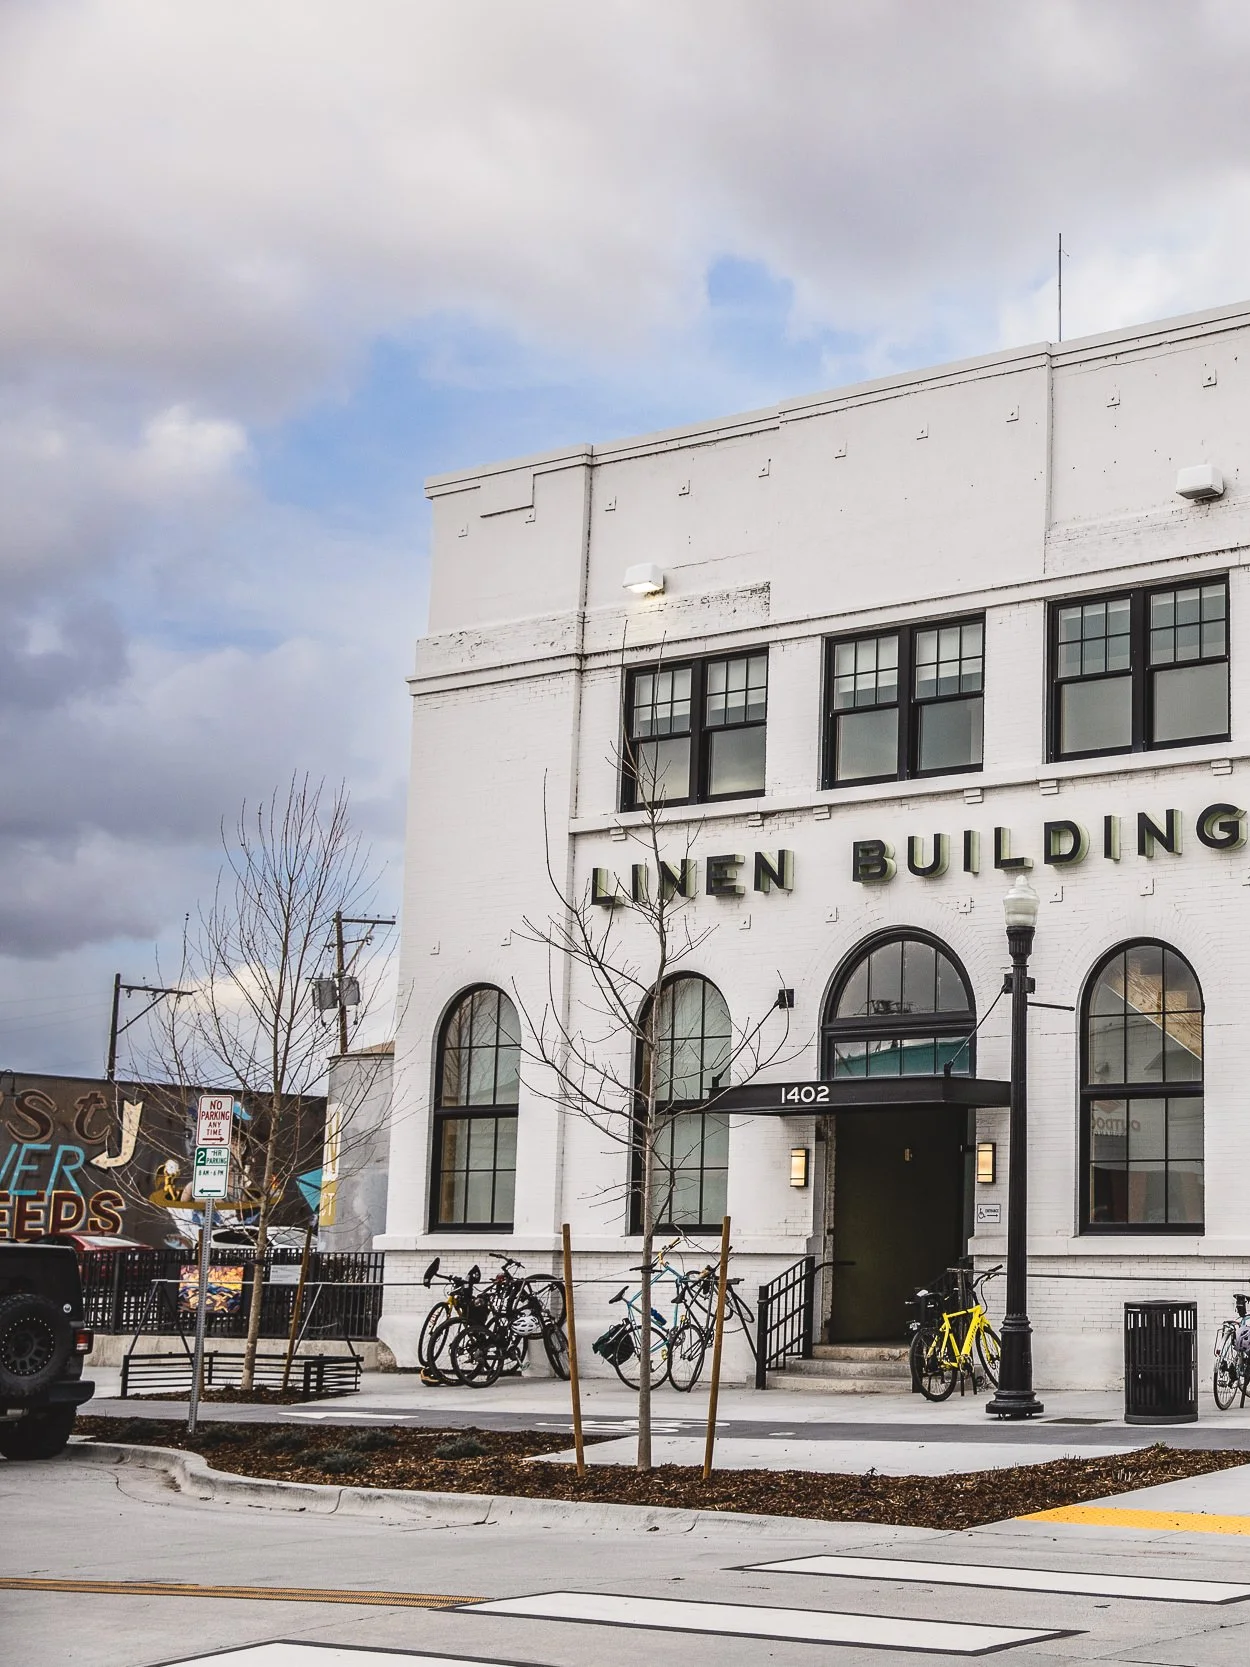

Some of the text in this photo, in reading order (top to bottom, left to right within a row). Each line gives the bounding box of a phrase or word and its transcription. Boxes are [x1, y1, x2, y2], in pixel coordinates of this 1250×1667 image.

[592, 803, 1248, 906] LINEN BUILDING
[781, 1086, 830, 1104] 1402
[210, 1100, 223, 1110] NO
[201, 1111, 230, 1120] PARKING
[197, 1150, 206, 1164] 2
